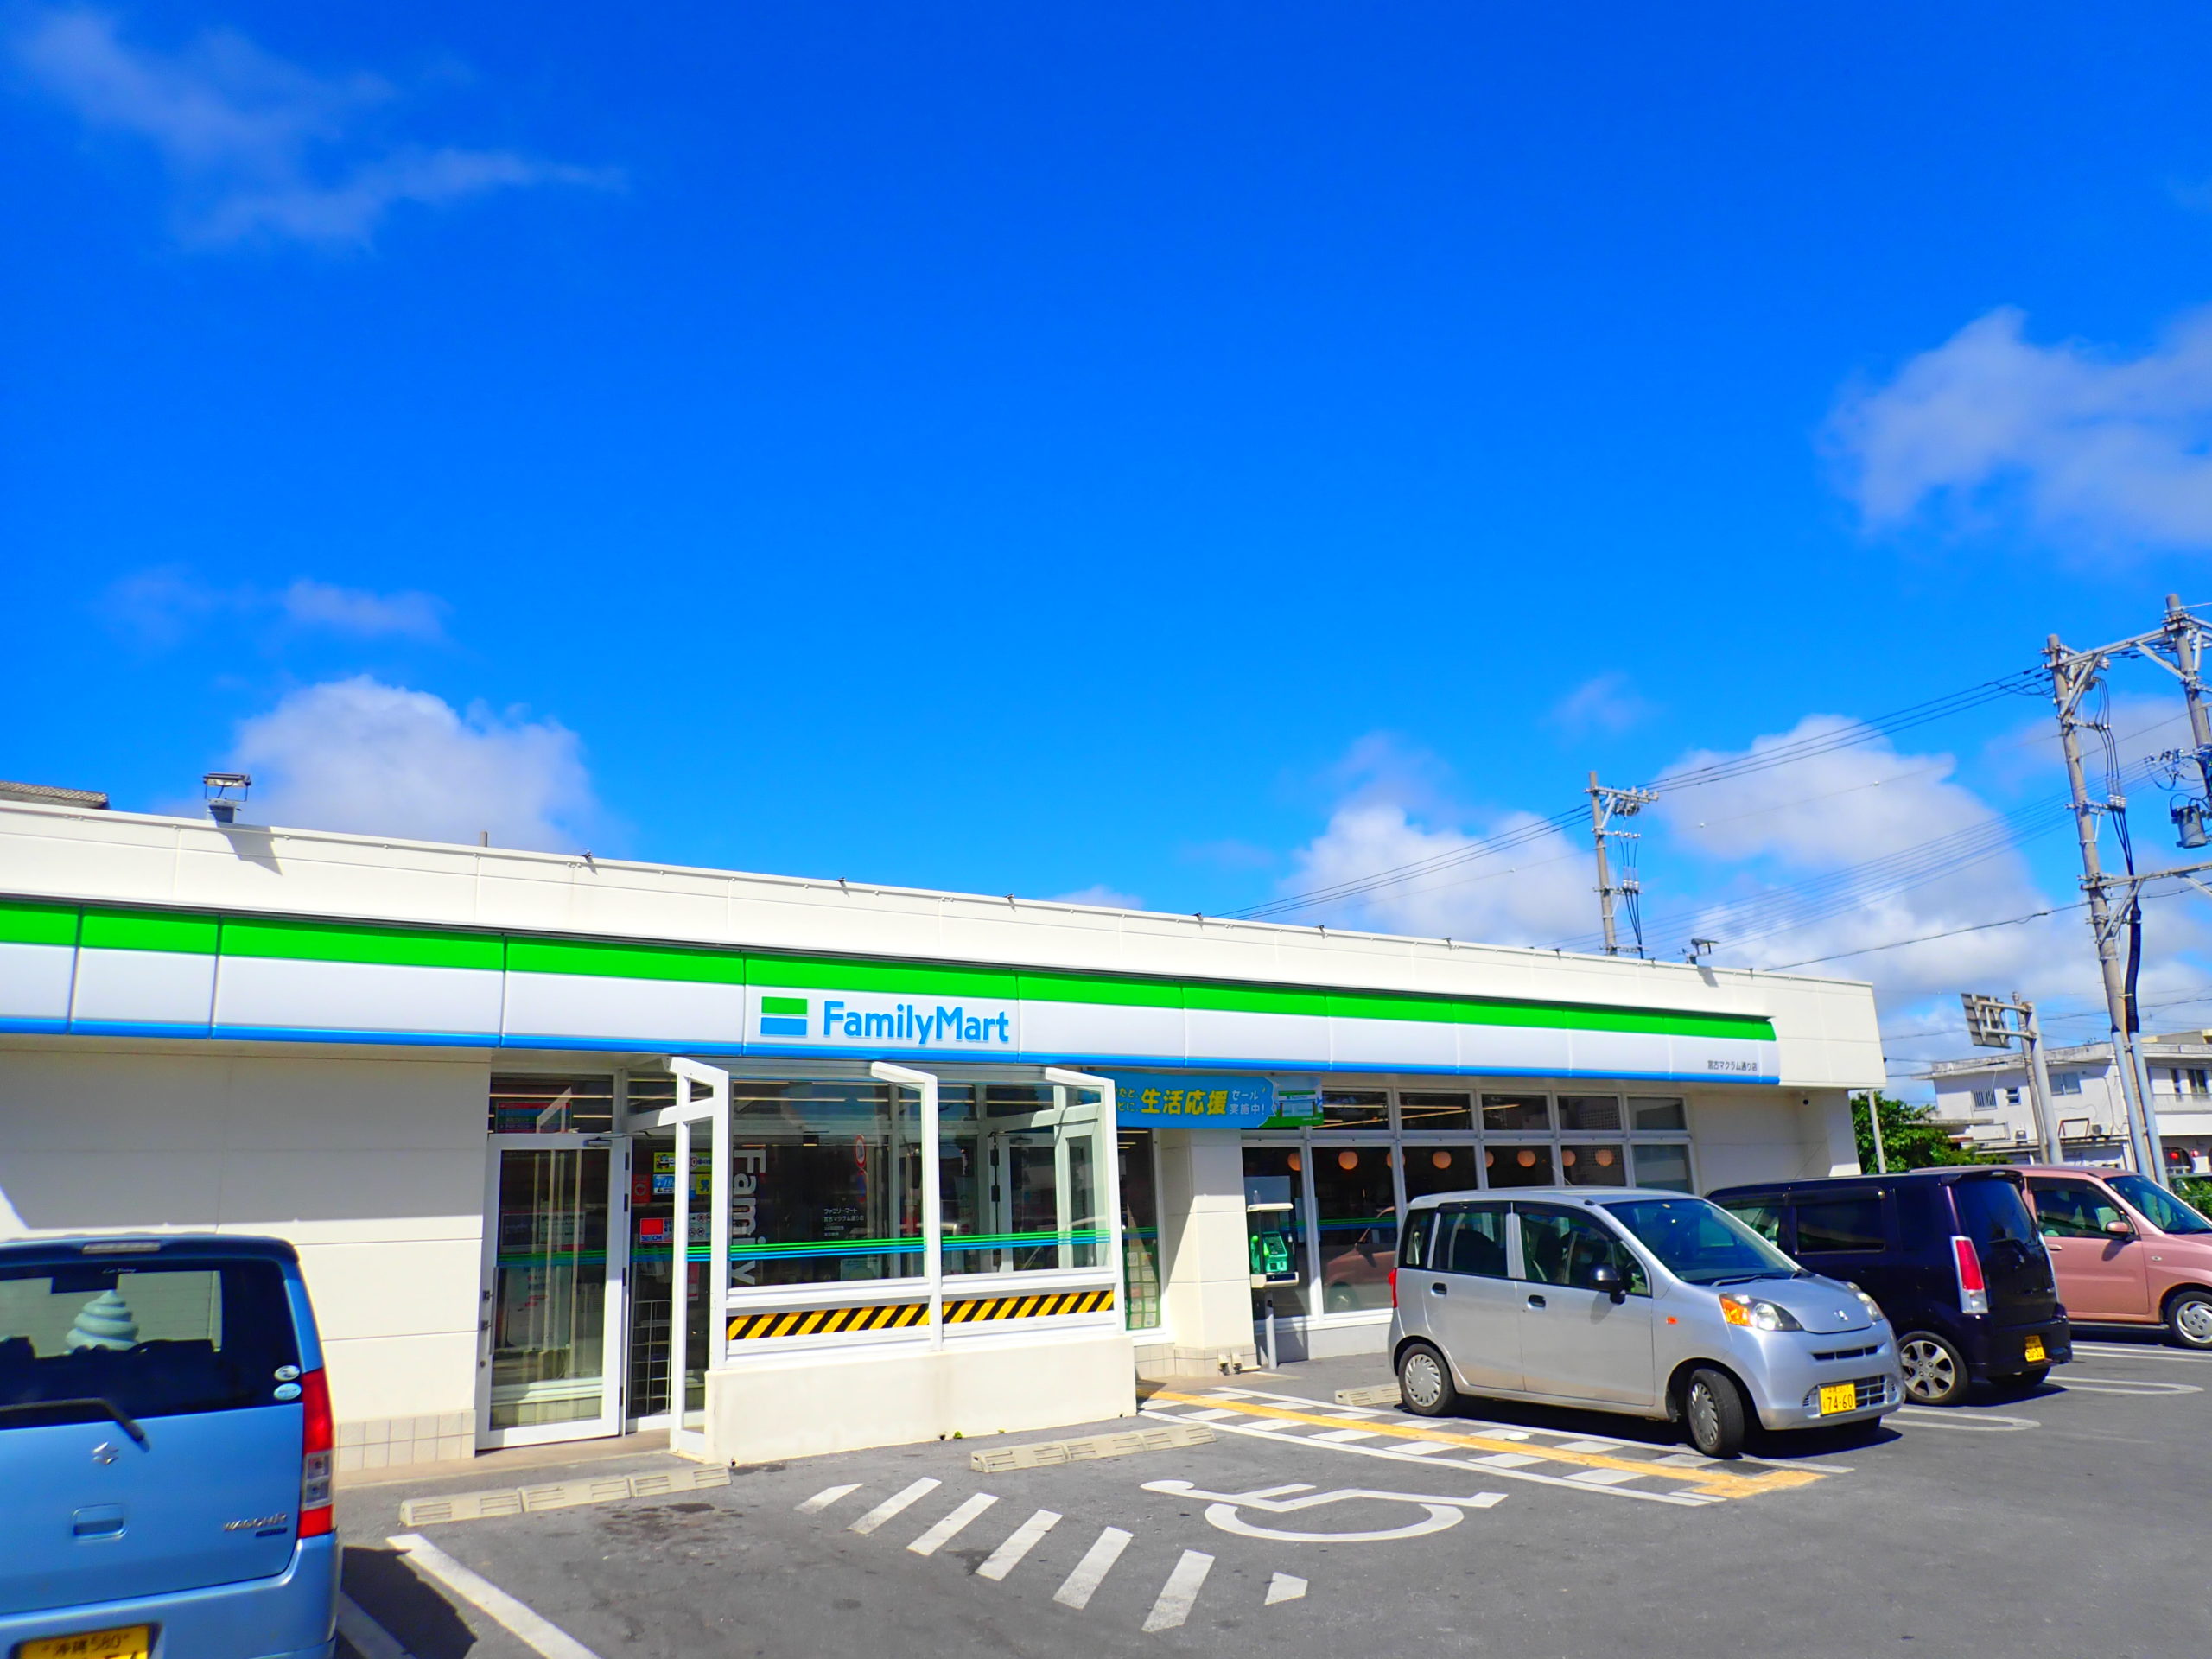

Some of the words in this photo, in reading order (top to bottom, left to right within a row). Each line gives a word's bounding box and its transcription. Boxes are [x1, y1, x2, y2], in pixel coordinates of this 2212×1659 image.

[823, 1001, 1009, 1045] FamilyMart
[1707, 1060, 1758, 1071] 宮古マクラム通り店
[1141, 1088, 1228, 1116] 生活応援
[1231, 1090, 1259, 1101] セール
[732, 1149, 766, 1285] Famiy
